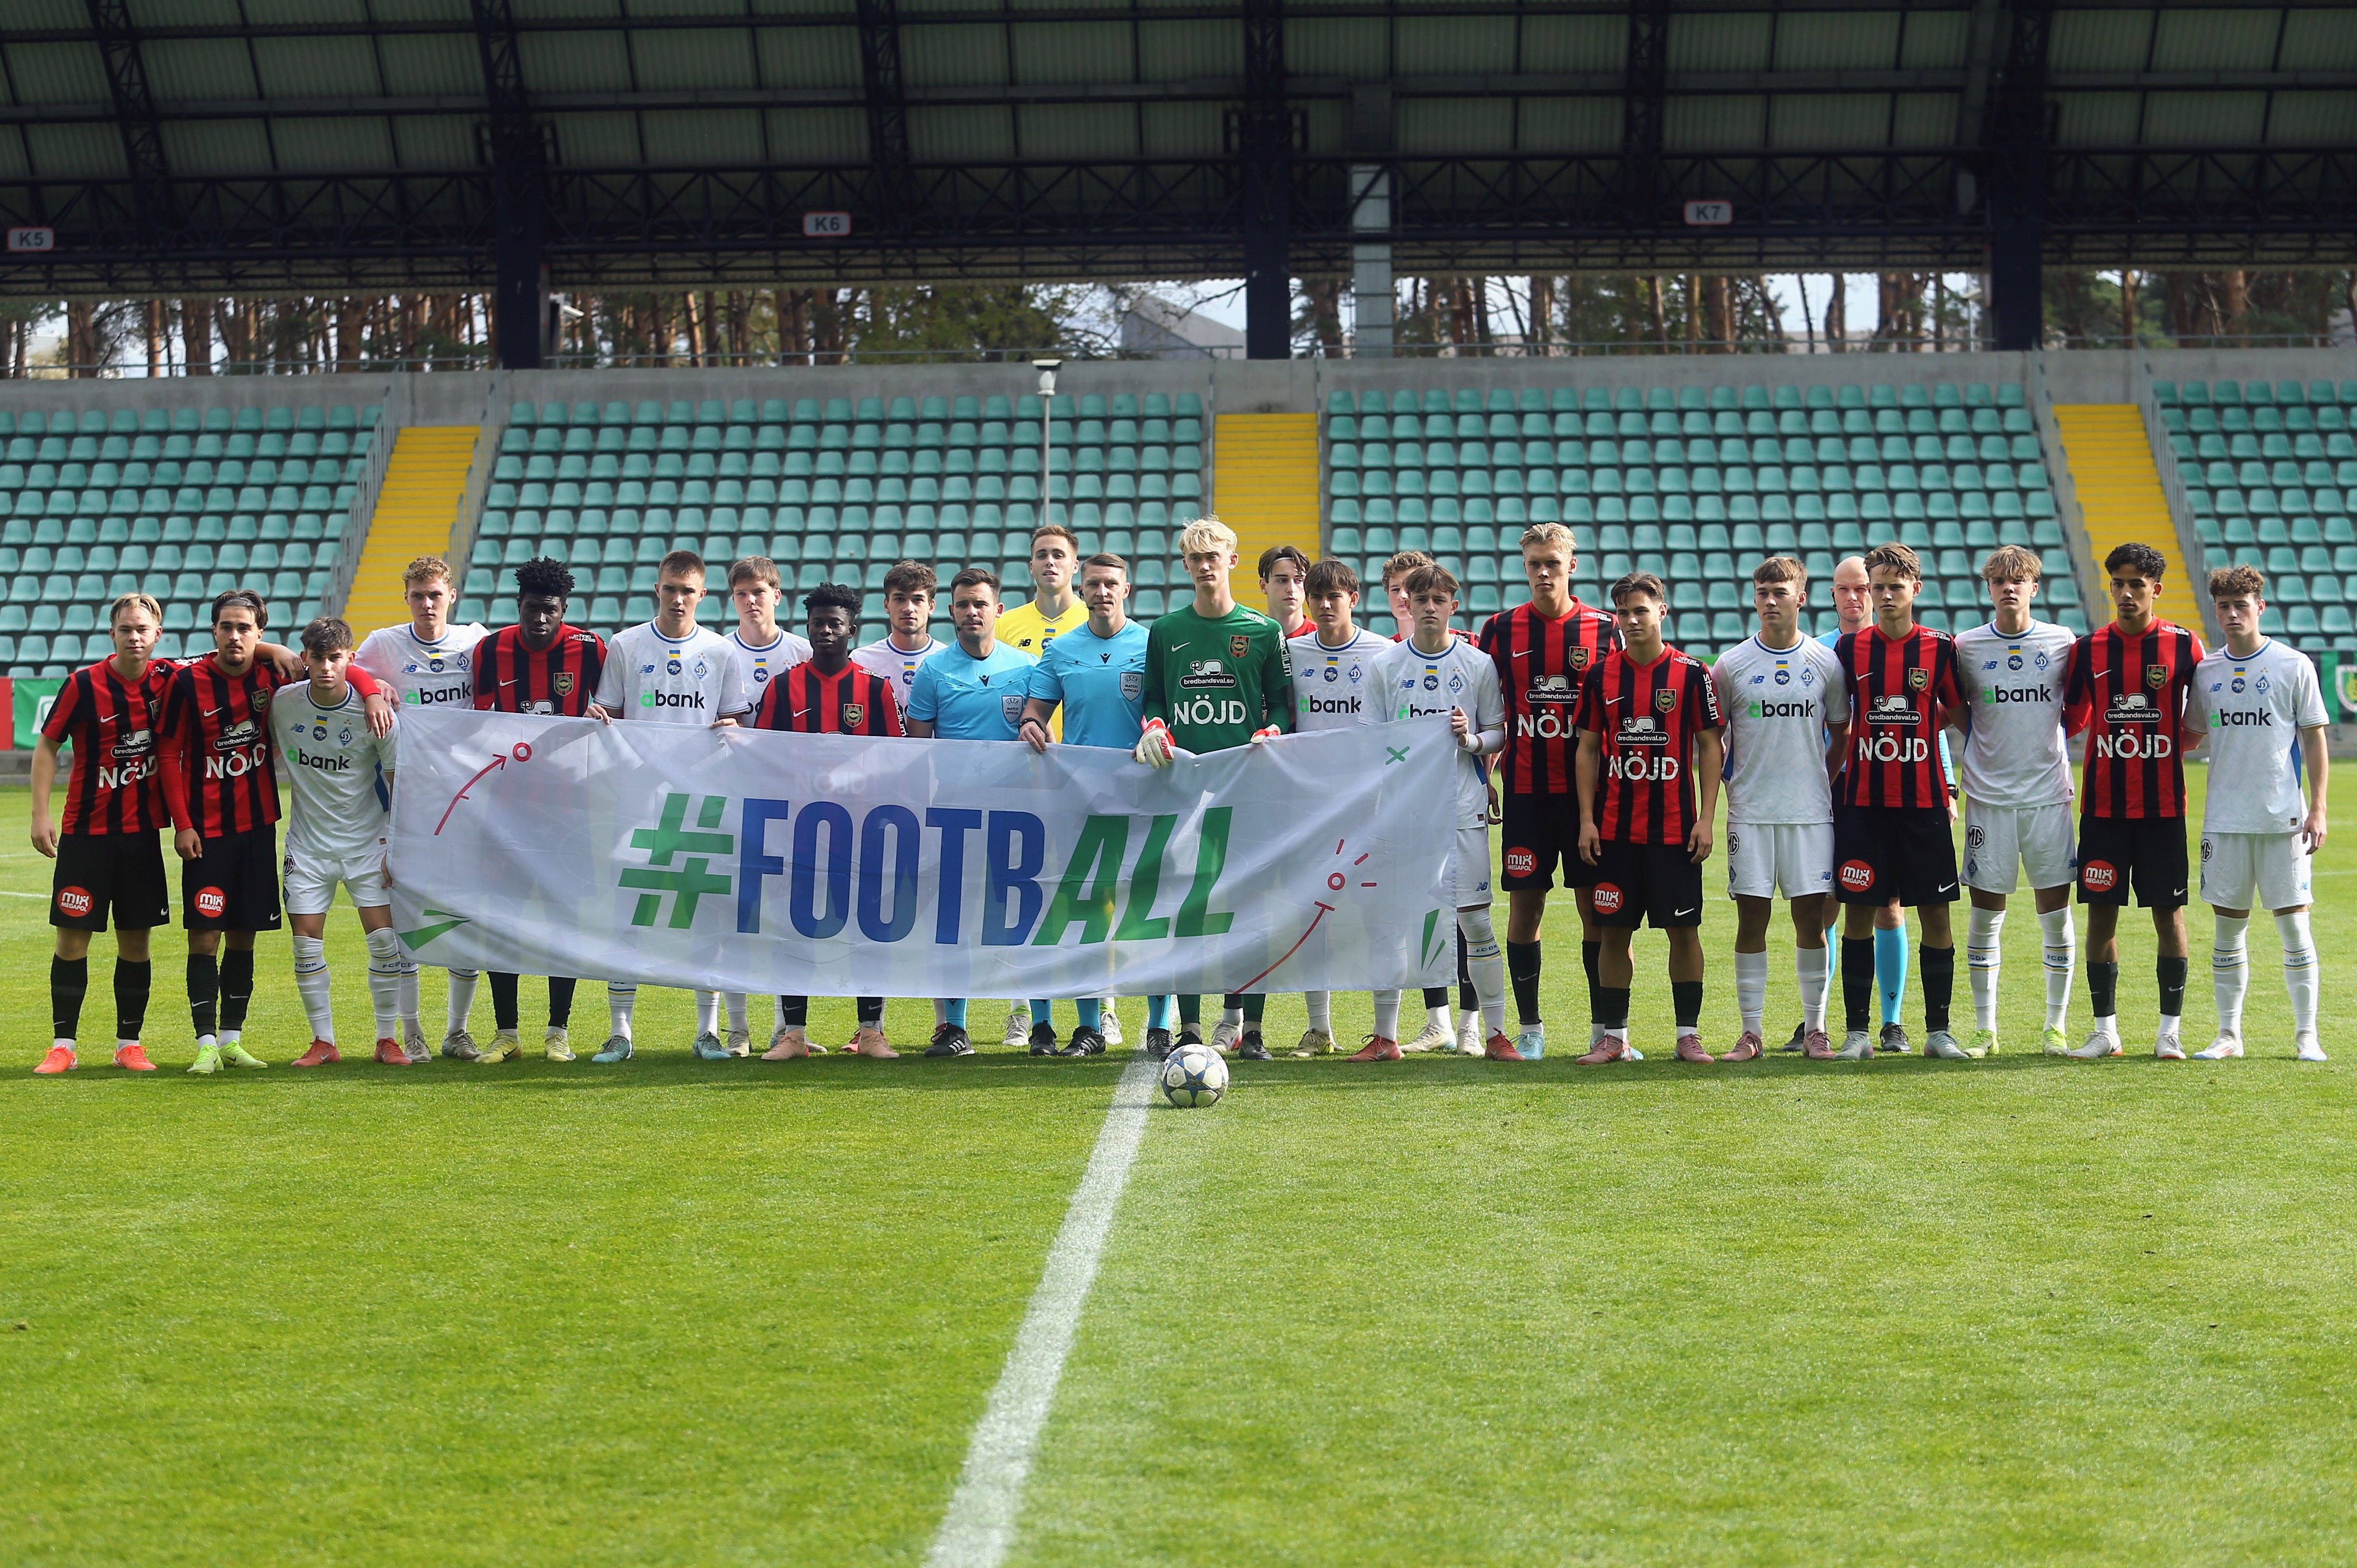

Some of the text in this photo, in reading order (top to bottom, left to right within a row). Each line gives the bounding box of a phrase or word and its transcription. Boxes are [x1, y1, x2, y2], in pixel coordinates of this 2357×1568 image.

[1695, 205, 1720, 221] K7
[814, 216, 840, 232] K6
[19, 231, 44, 247] K5
[1183, 677, 1234, 685] bredbandsval.se
[1702, 673, 1721, 721] stadium
[1174, 694, 1246, 726] NÖJD
[1517, 708, 1580, 739] NÖJ
[1859, 731, 1929, 763] NÖJD
[2097, 728, 2171, 759] NÖJD
[99, 755, 159, 789] NÖJD
[1608, 750, 1679, 781] NÖJD
[1968, 828, 1983, 847] MG
[618, 792, 1235, 946] #FOOTBALL
[1841, 876, 1868, 887] MEGAPOL
[2085, 878, 2112, 886] MEGAPOL
[61, 902, 87, 912] MEGAPOL
[199, 903, 222, 912] MEGAPOL
[1595, 900, 1618, 908] MEGAPOL
